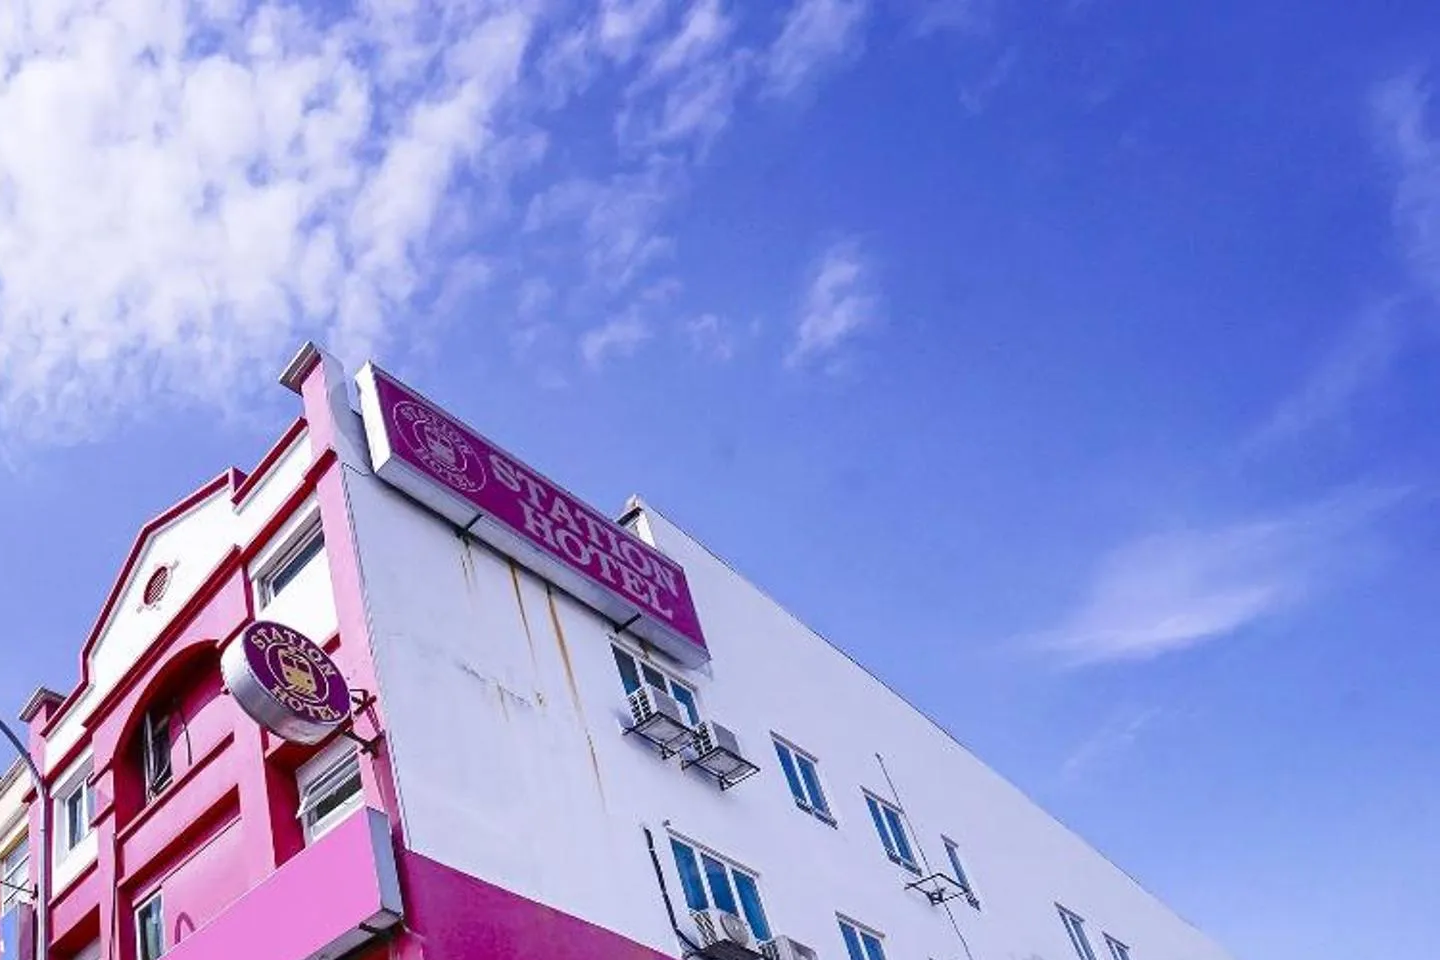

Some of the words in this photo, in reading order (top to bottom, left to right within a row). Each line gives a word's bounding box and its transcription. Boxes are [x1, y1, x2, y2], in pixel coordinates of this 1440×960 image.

[489, 453, 679, 598] STATION
[518, 499, 674, 622] HOTEL
[250, 626, 337, 678] STATION
[270, 682, 342, 722] HOTEL
